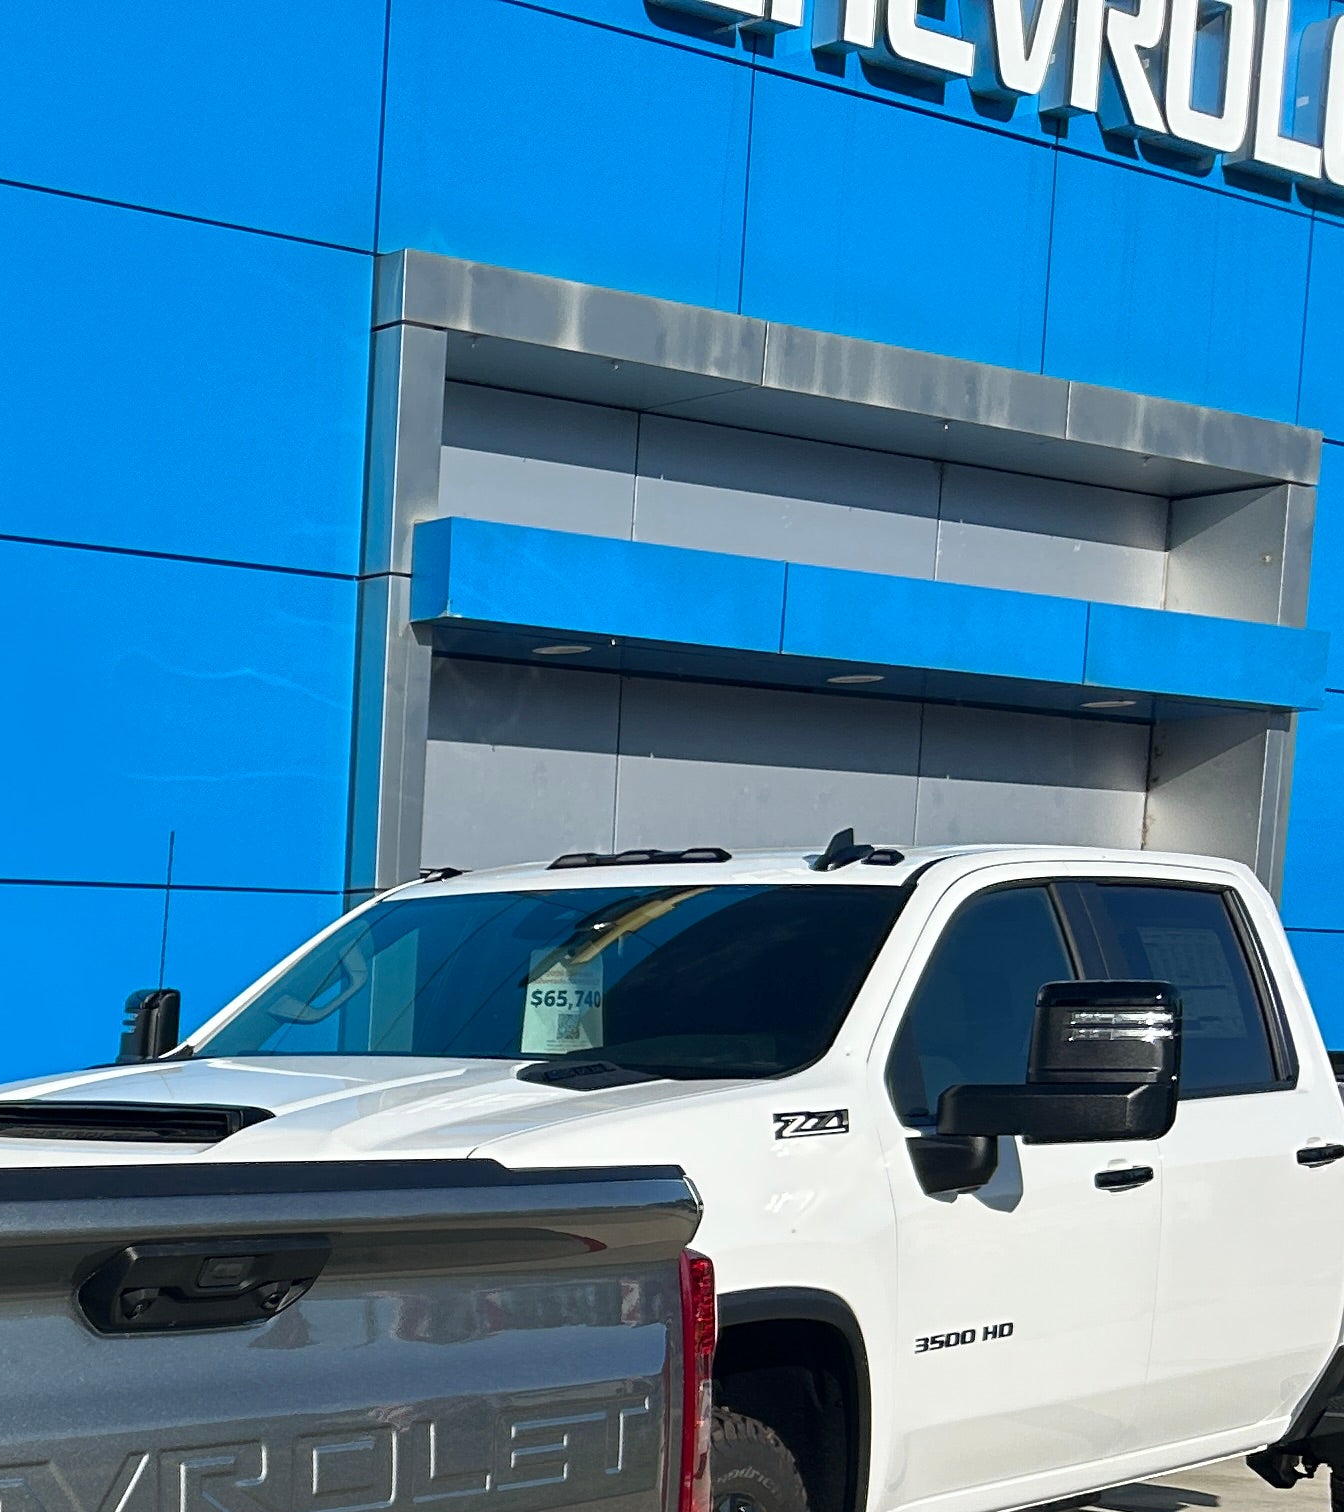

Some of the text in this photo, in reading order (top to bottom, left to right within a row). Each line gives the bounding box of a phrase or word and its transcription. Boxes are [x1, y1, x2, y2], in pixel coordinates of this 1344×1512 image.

[530, 988, 602, 1010] $65,740
[914, 1322, 1014, 1354] 3500 HD
